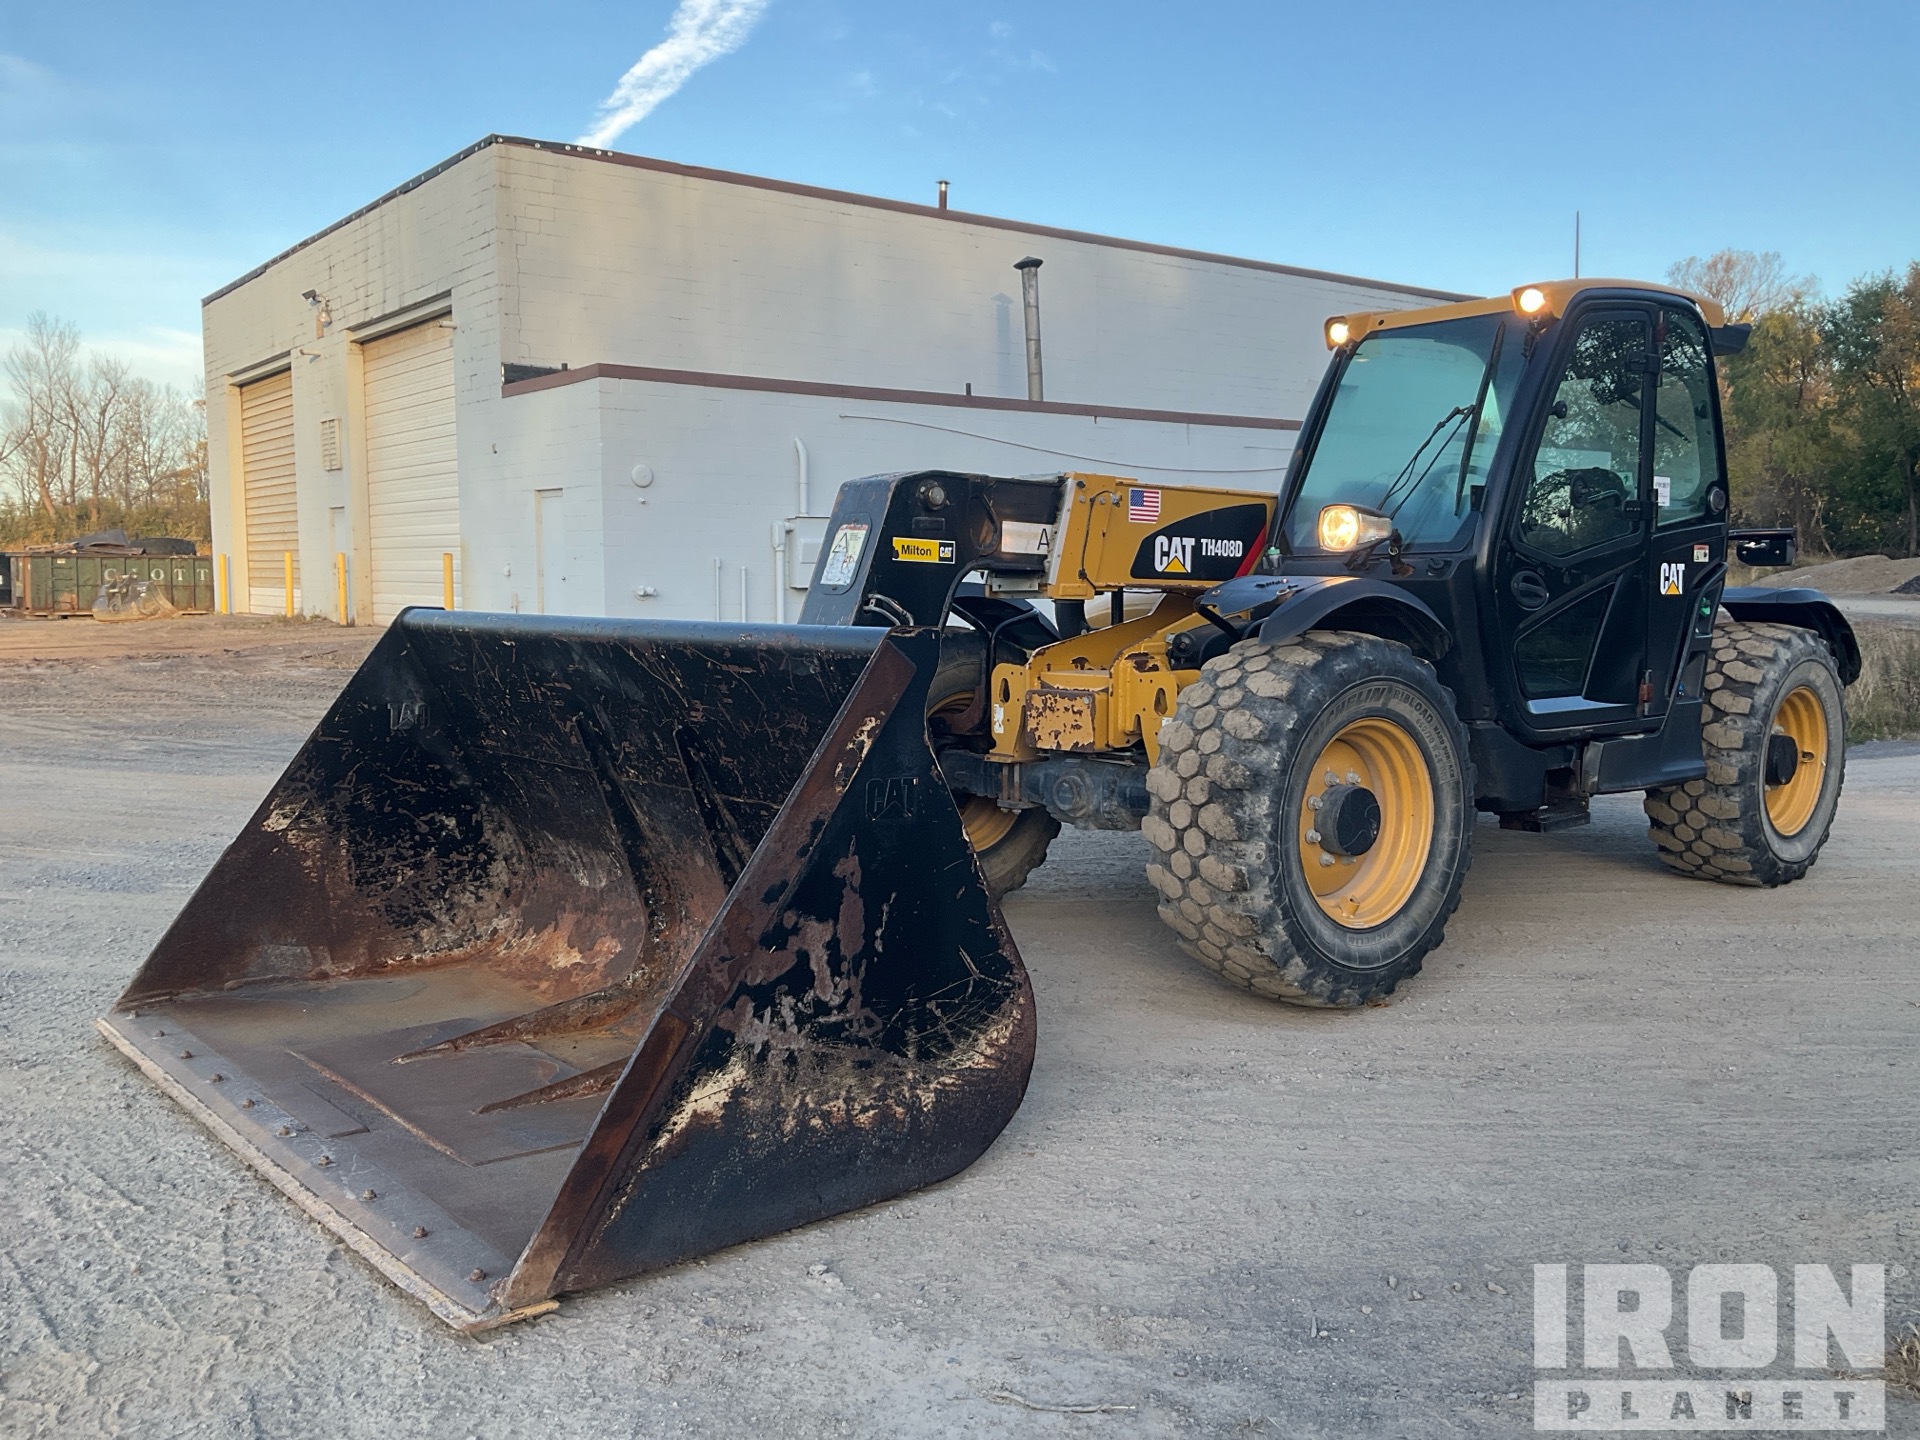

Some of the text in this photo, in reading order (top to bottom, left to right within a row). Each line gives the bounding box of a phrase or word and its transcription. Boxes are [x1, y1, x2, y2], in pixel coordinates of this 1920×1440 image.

[901, 544, 953, 558] Milton CAT
[1036, 527, 1050, 551] A
[1154, 534, 1243, 573] CAT TH408D
[1660, 562, 1685, 595] CAT
[865, 776, 919, 821] CAT
